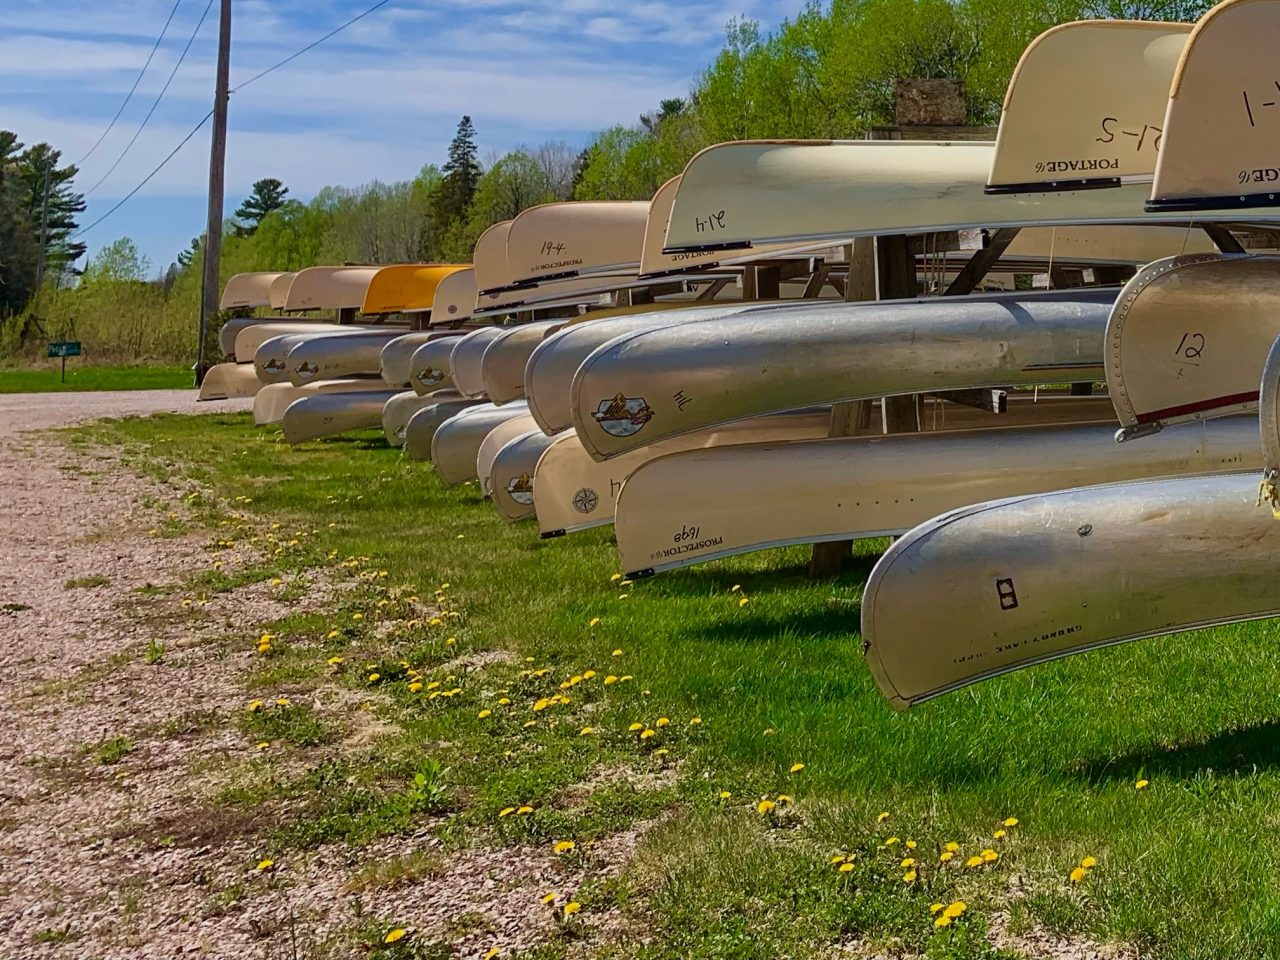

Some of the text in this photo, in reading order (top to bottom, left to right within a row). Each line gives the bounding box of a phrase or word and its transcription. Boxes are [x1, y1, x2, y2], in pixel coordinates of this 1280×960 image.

[1095, 117, 1162, 151] 21-5
[695, 210, 726, 233] 21-4
[540, 241, 566, 256] 19-4
[1175, 332, 1205, 358] 12
[673, 524, 701, 543] 1698
[663, 536, 724, 558] PROSPECTOR
